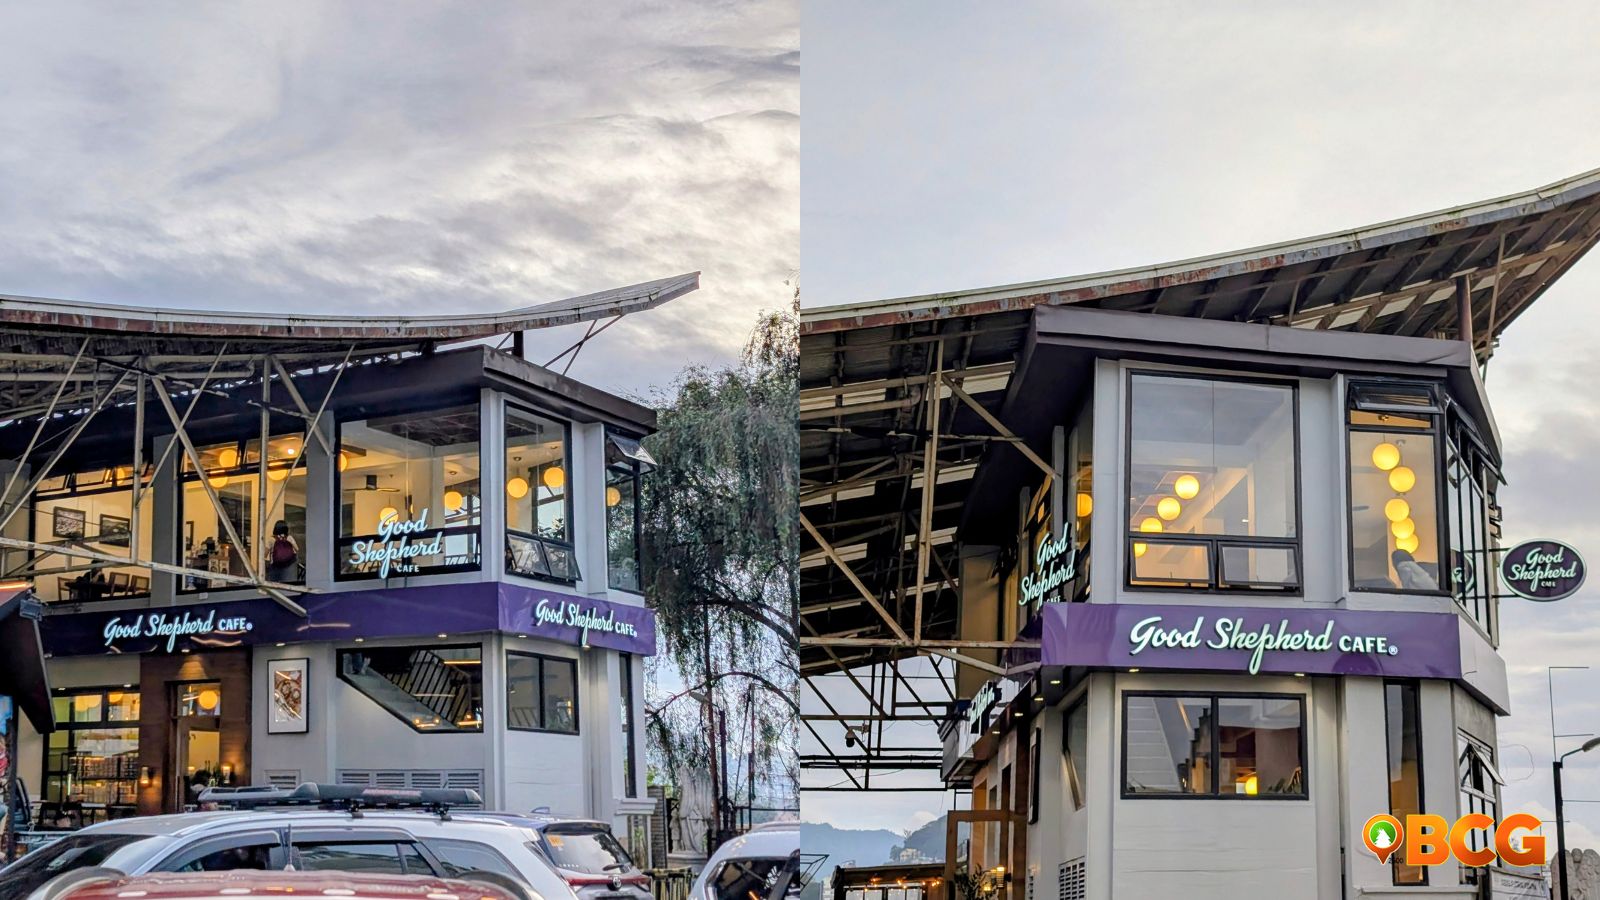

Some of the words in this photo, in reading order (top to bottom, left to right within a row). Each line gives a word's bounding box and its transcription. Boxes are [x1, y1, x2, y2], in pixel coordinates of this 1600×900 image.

[378, 508, 428, 544] Good
[1036, 522, 1068, 576] Good
[349, 531, 443, 579] Shepherd
[396, 564, 420, 573] CAFE
[1507, 561, 1577, 592] Shepherd
[1526, 546, 1564, 570] Good
[1018, 548, 1075, 611] Shepherd
[104, 614, 144, 646] Good
[144, 609, 216, 653] Shepherd
[535, 599, 564, 627] Good
[565, 603, 614, 647] Shepherd
[1129, 616, 1205, 655] Good
[1206, 617, 1335, 676] Shepherd
